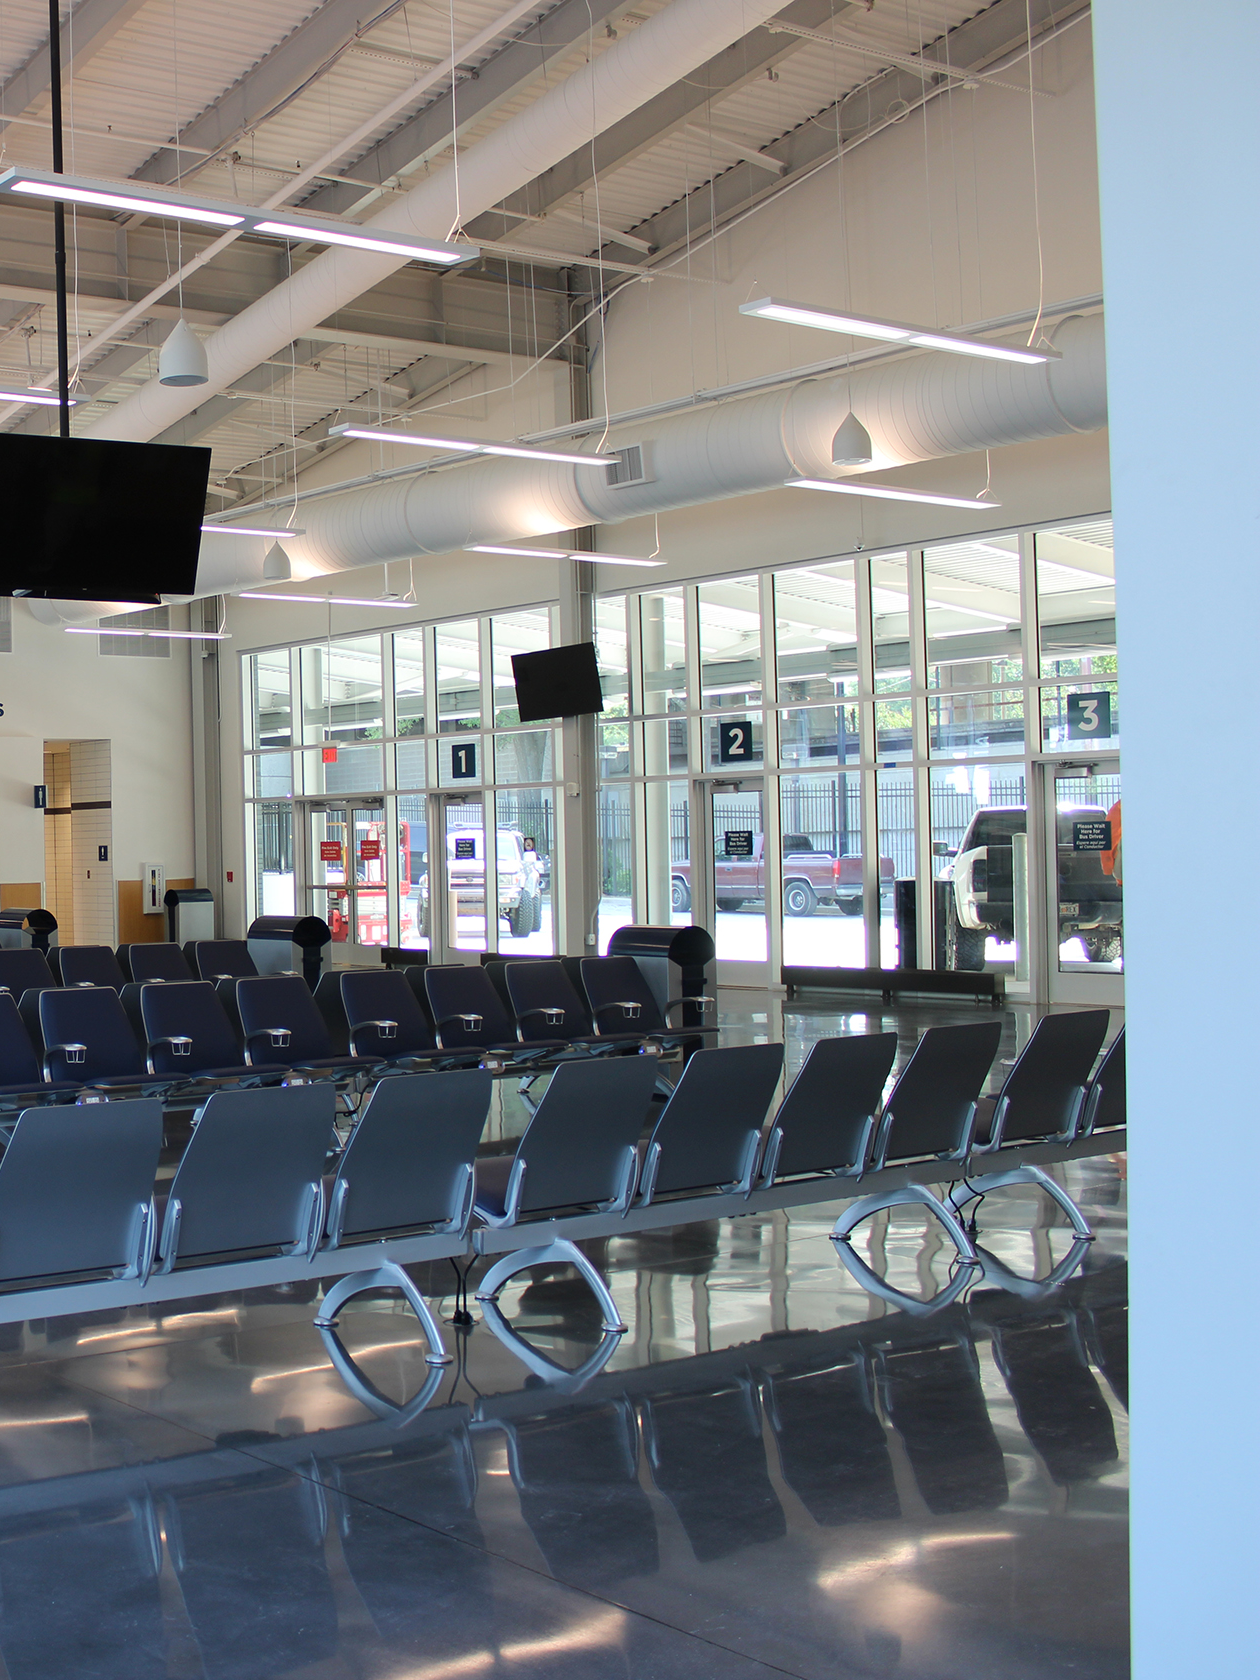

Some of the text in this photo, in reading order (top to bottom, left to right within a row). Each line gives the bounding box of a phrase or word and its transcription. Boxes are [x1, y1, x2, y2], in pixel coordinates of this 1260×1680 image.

[1078, 699, 1099, 731] 3
[728, 727, 745, 755] 2
[458, 750, 466, 773] 1
